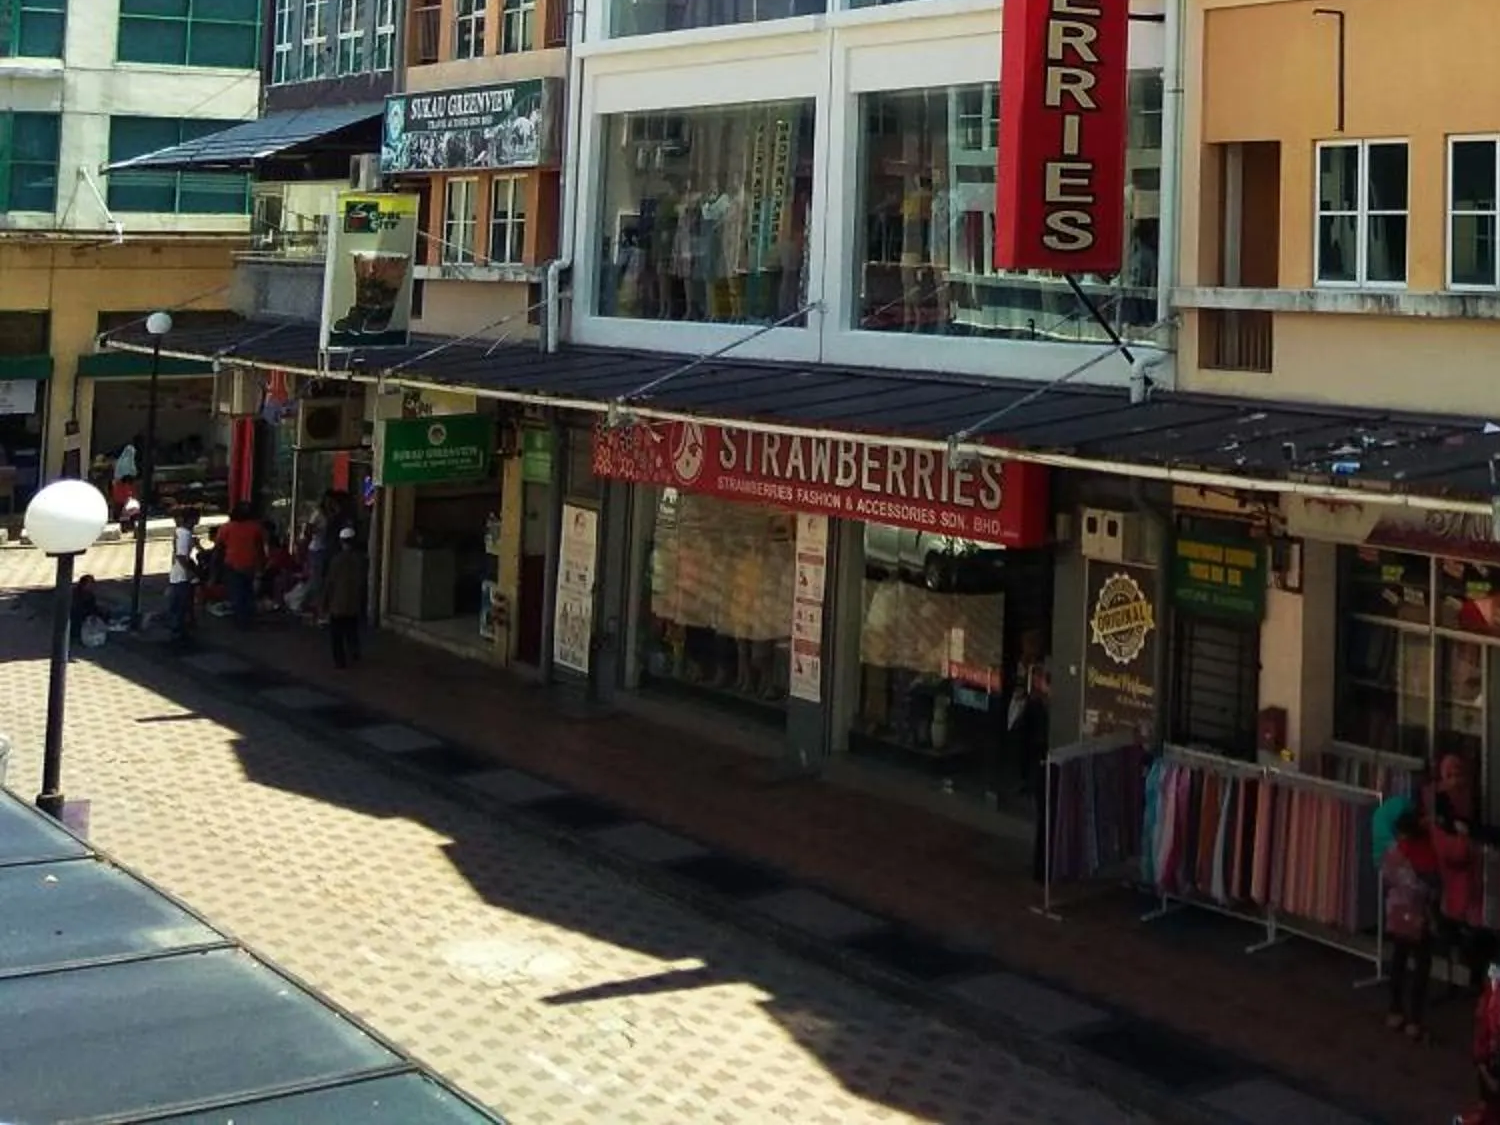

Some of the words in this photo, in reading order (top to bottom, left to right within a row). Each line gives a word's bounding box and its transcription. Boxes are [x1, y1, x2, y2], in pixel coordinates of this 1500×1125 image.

[410, 96, 447, 120] SUKAU
[448, 88, 515, 115] GREENVIEW
[719, 426, 1002, 510] STRAWBERRIES
[717, 476, 793, 501] STRAWBERRIES
[798, 488, 840, 511] FASHION
[856, 498, 936, 525] ACCESSORIES
